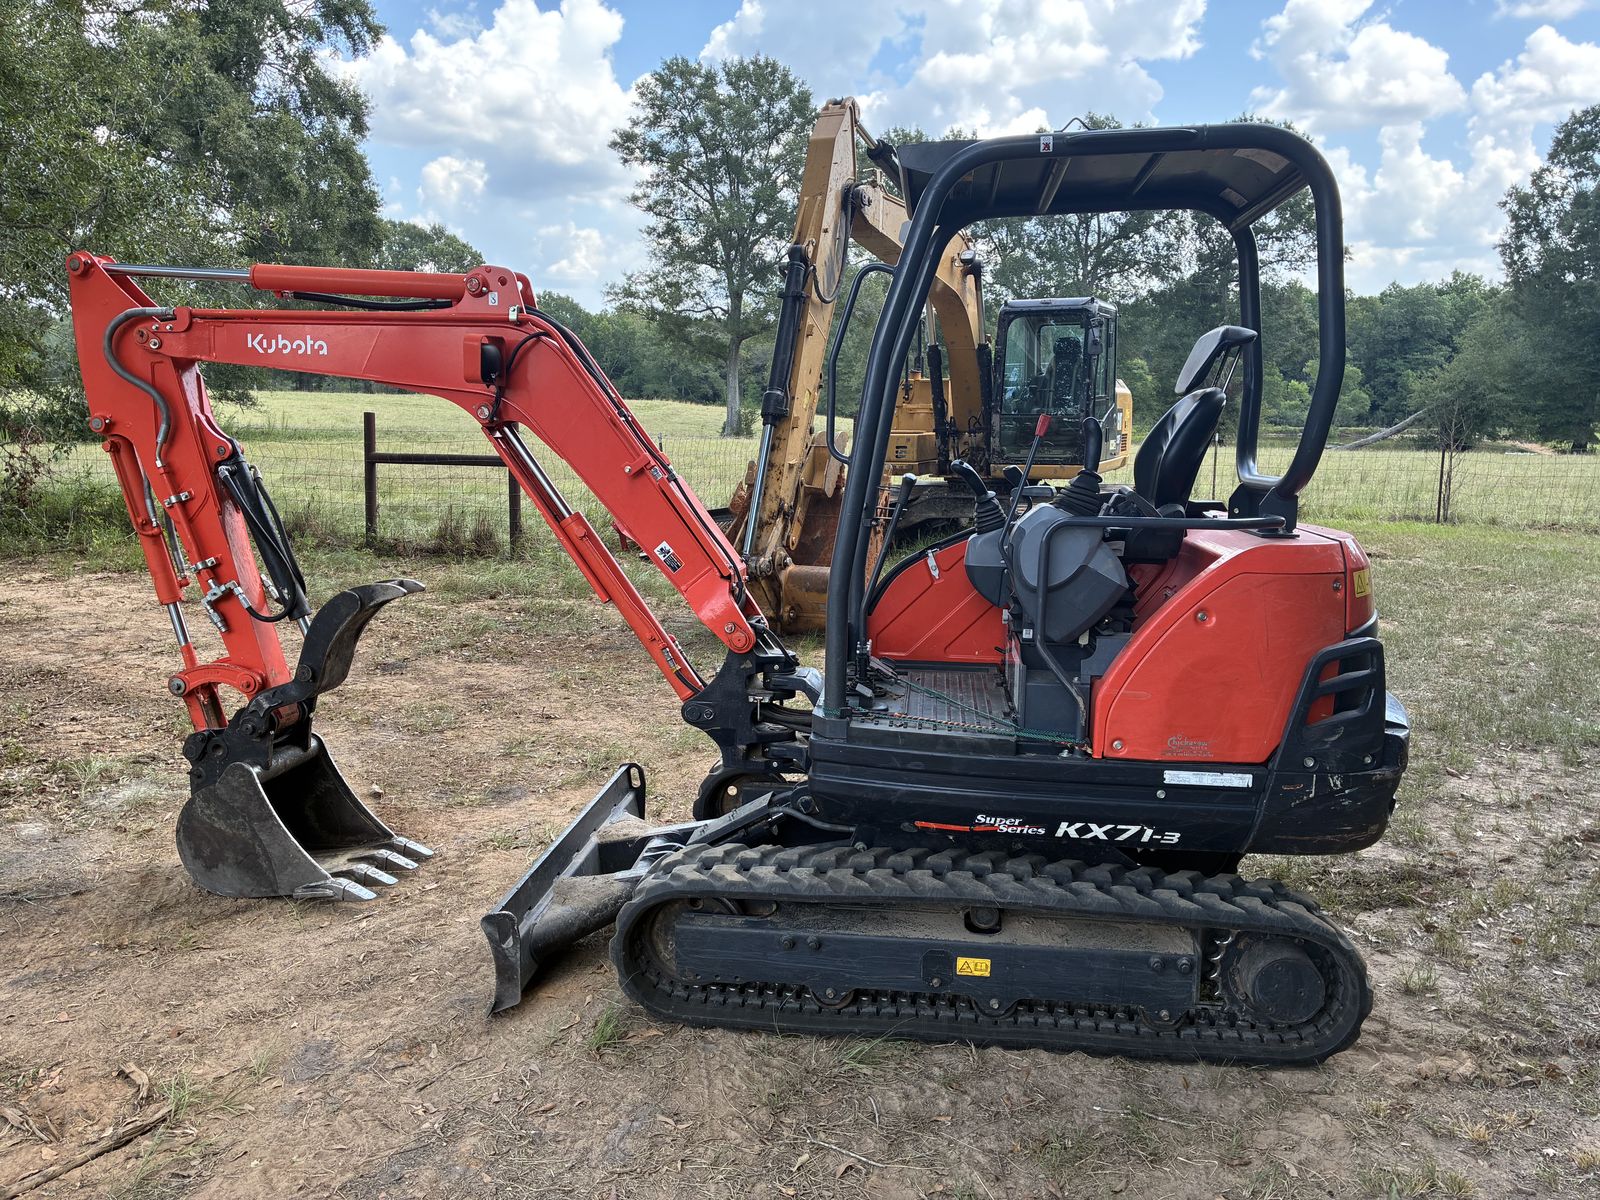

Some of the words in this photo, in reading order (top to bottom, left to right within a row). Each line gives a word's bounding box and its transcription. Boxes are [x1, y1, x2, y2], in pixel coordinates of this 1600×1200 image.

[247, 333, 328, 355] Kubota
[975, 814, 1023, 826] Super
[997, 824, 1046, 835] Series
[1054, 821, 1181, 844] KX71-3
